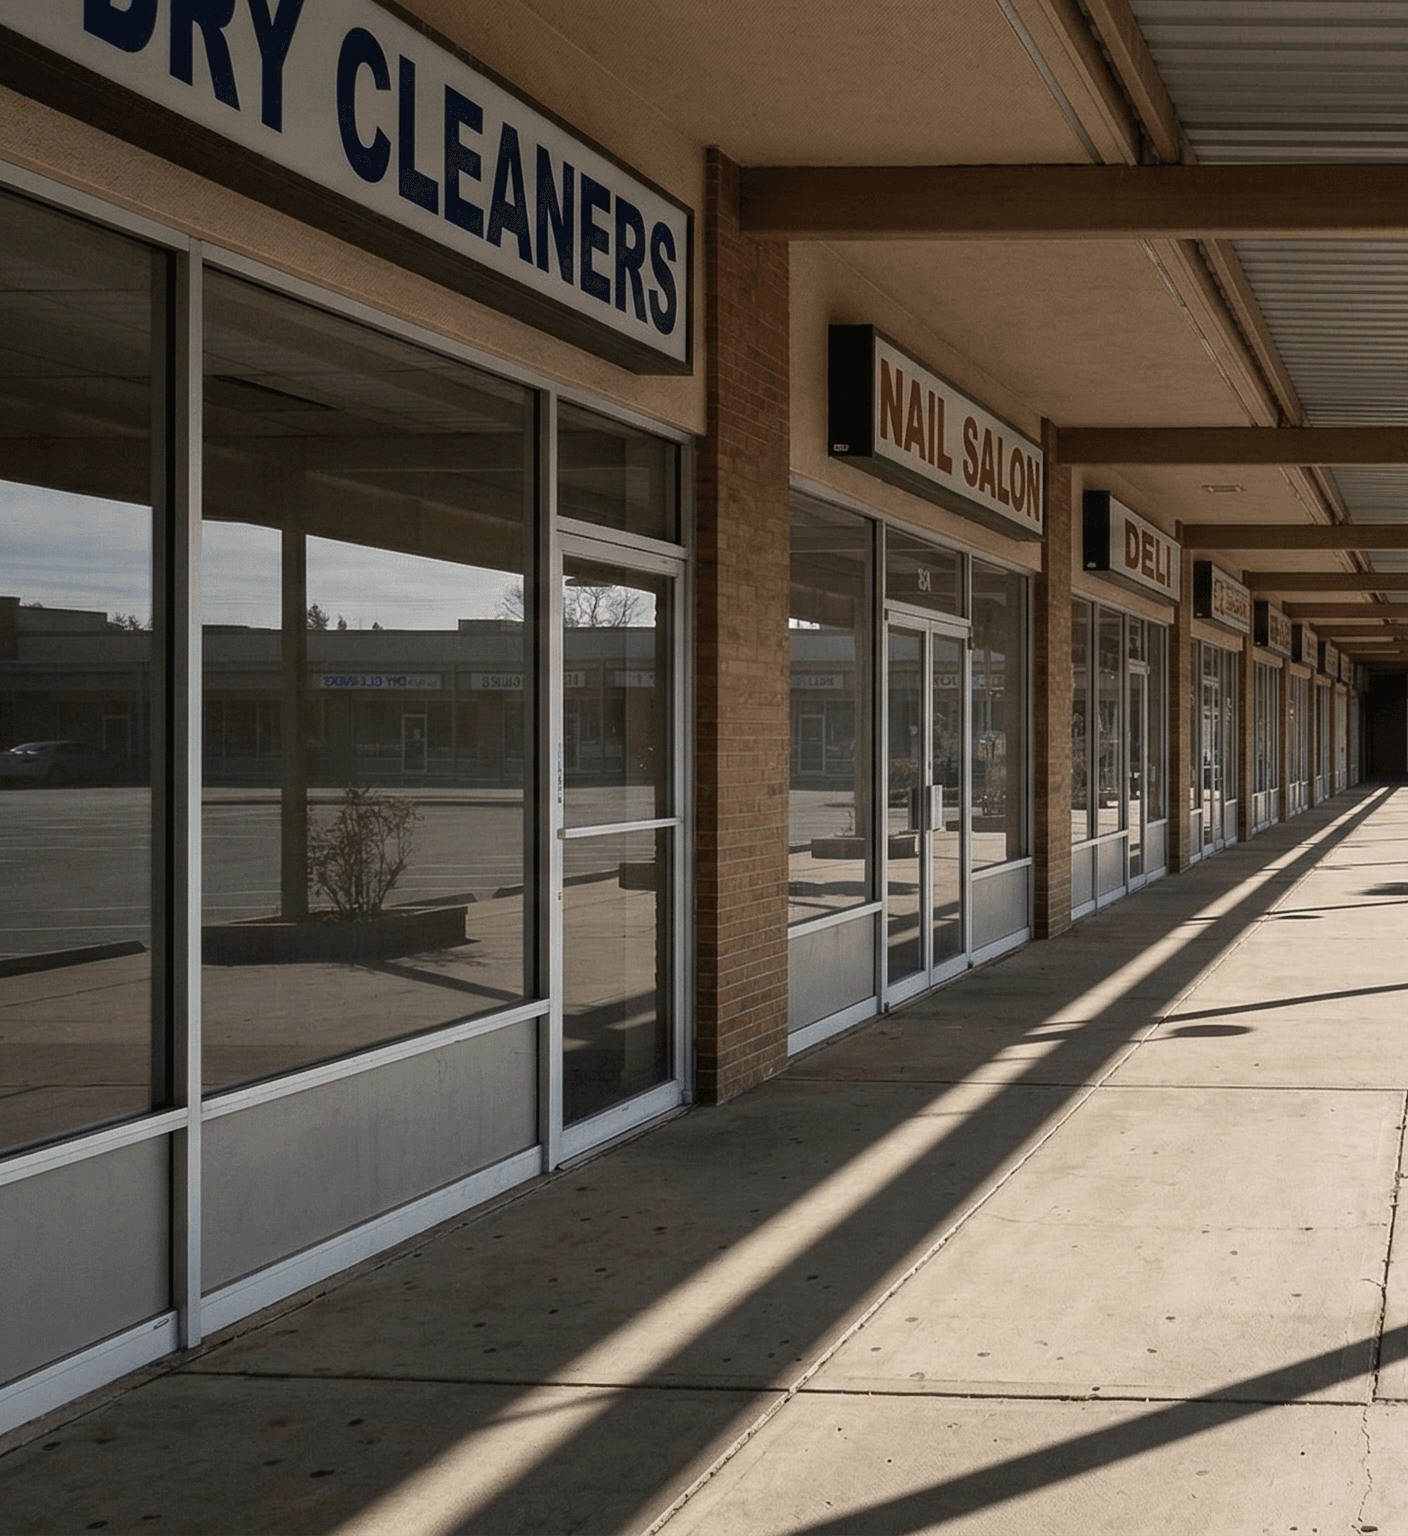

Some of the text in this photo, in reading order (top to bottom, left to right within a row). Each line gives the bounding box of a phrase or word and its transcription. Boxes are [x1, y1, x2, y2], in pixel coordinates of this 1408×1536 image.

[336, 27, 677, 336] CLEANERS
[880, 357, 1040, 522] NAIL SALON
[1124, 517, 1172, 588] DELI
